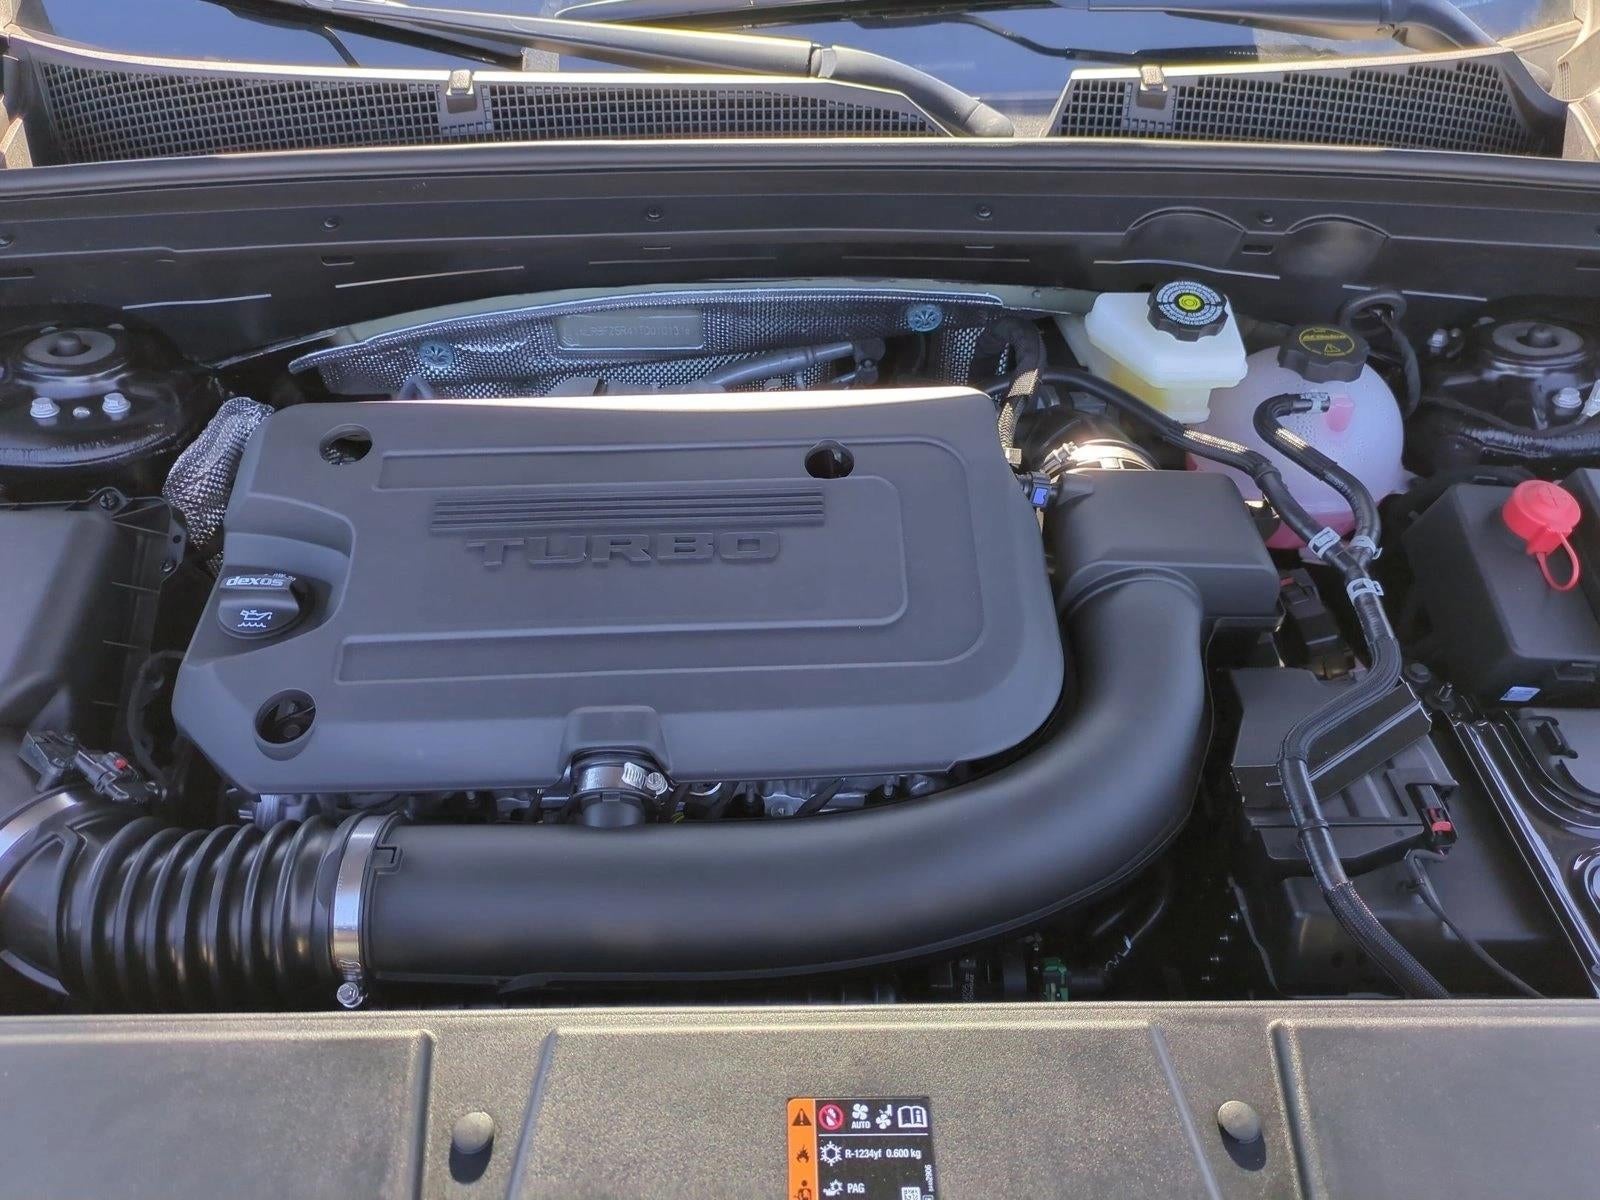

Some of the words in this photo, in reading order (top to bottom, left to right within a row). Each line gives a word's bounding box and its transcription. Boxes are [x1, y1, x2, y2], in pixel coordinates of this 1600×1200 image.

[466, 531, 780, 568] TURBO
[226, 575, 284, 587] dexos
[851, 1121, 871, 1129] AUTO
[845, 1149, 882, 1160] R-1234yf
[886, 1149, 909, 1158] 0.600
[910, 1149, 923, 1159] kg
[847, 1183, 866, 1194] PAG
